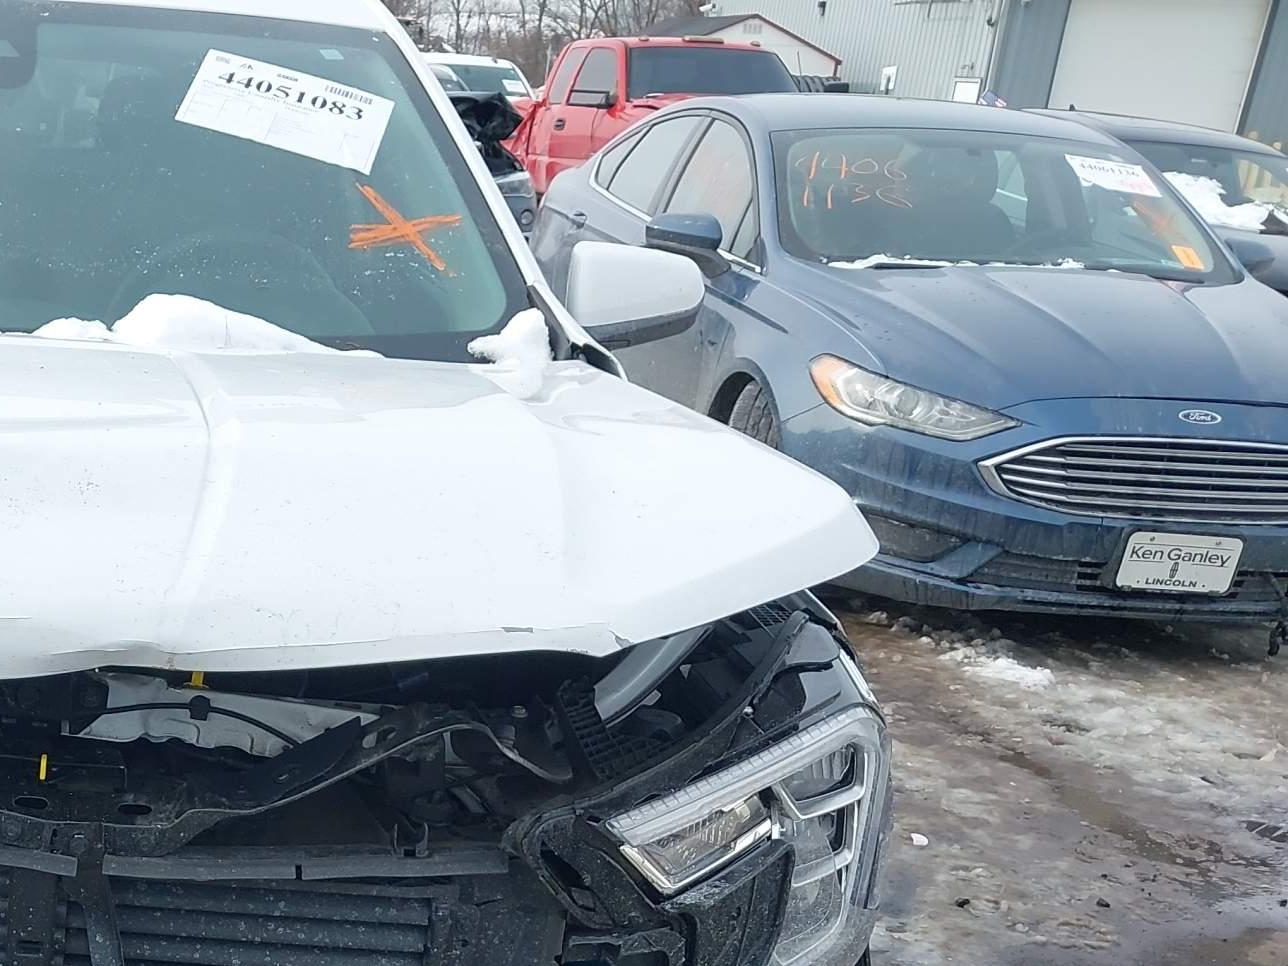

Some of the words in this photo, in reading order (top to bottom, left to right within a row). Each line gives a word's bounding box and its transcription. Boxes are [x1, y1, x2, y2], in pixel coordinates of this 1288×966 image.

[218, 71, 364, 121] 44051083
[1188, 412, 1213, 421] Ford
[1129, 545, 1164, 561] Ken
[1167, 547, 1232, 567] Ganley
[1144, 577, 1198, 588] LINCOLN
